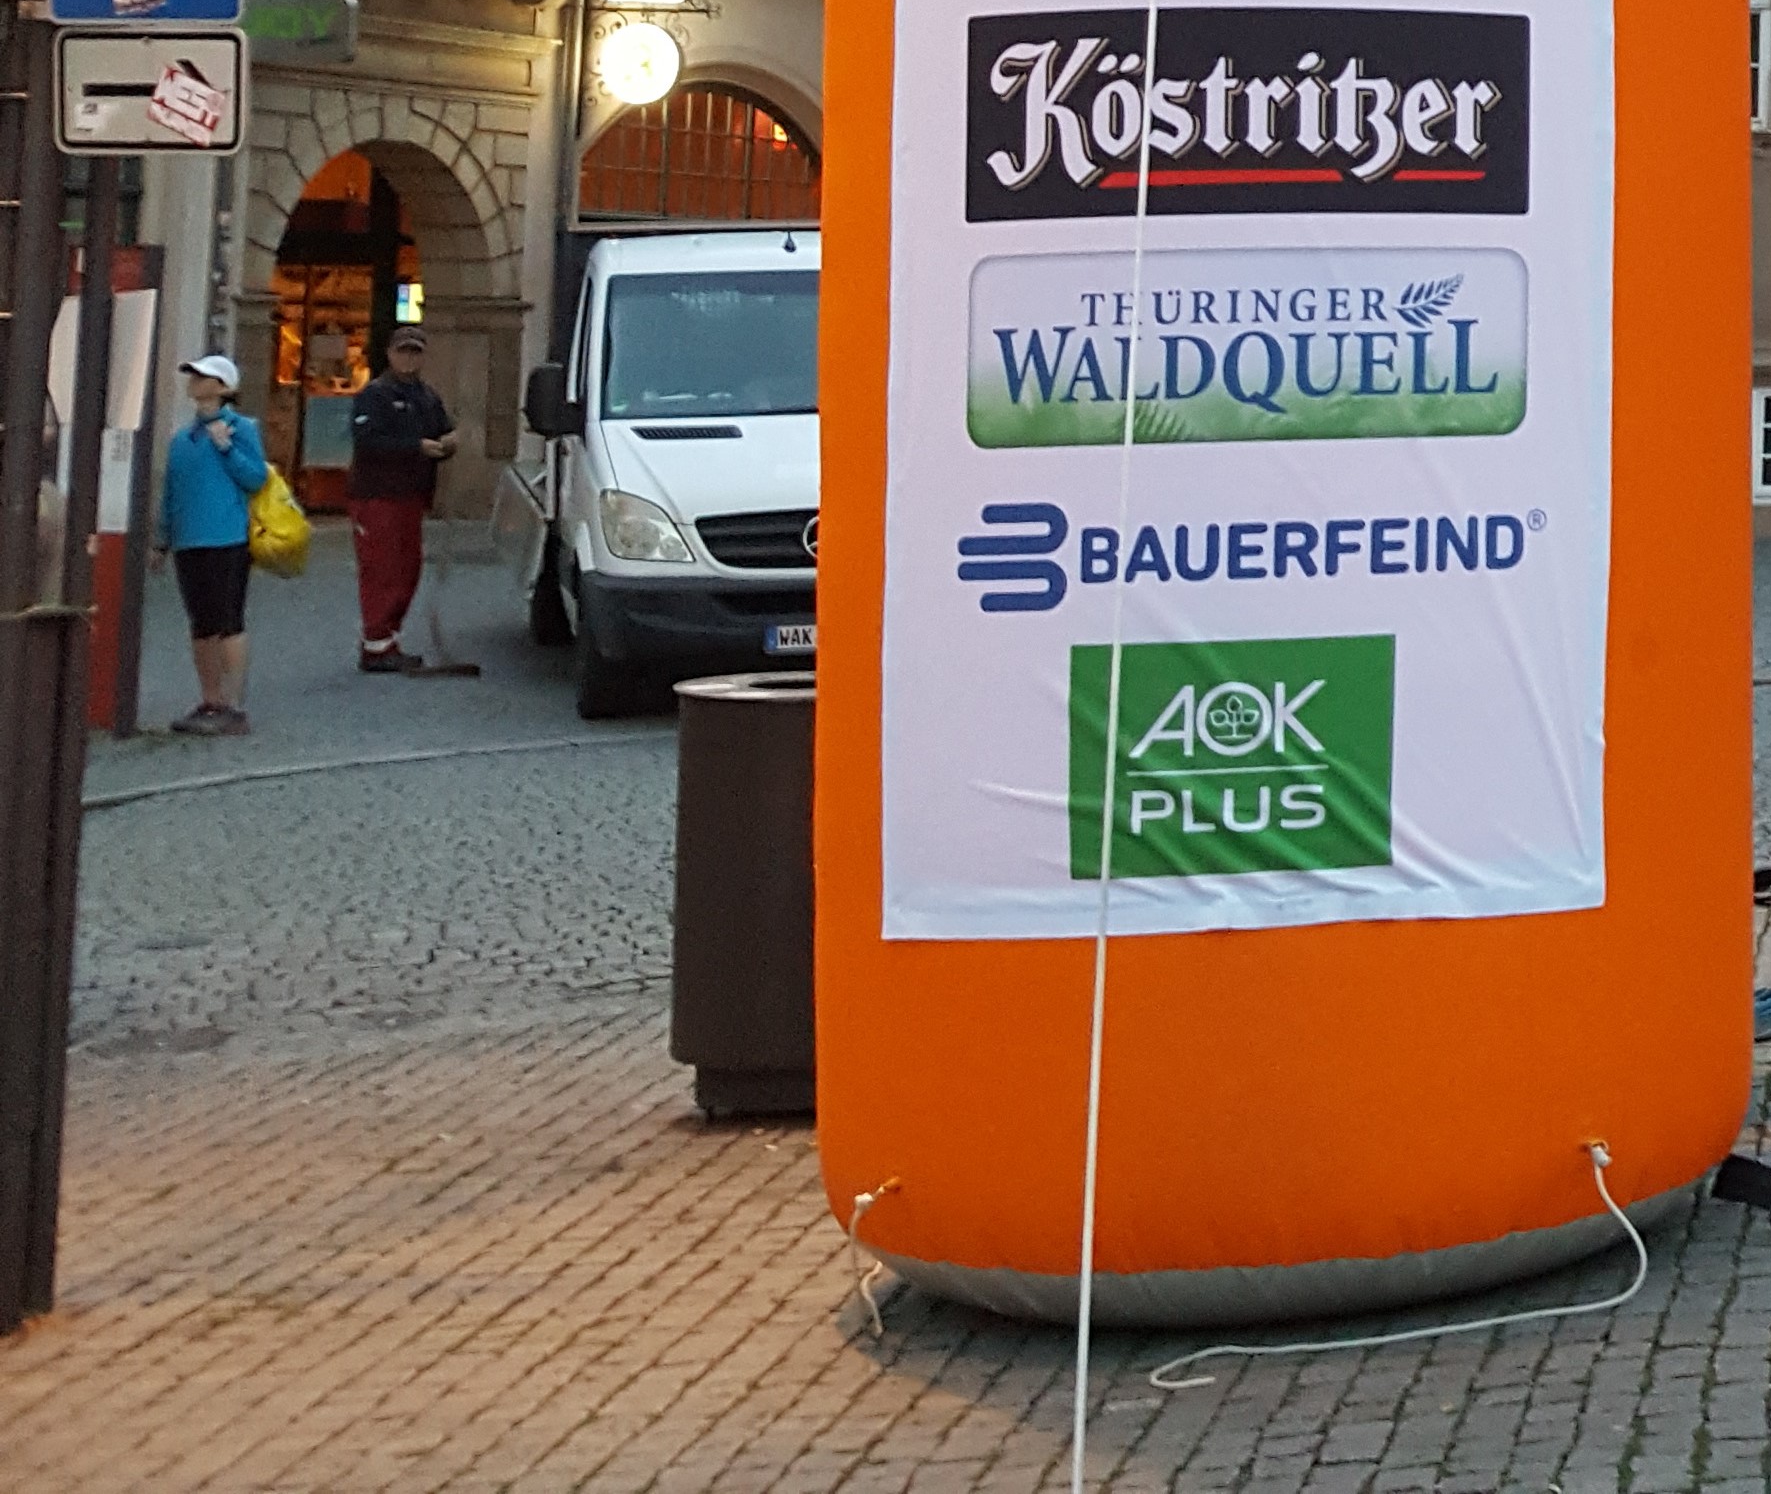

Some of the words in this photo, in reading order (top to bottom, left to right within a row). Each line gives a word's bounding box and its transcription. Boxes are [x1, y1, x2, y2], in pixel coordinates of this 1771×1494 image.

[986, 36, 1503, 190] Köstritzer
[1081, 288, 1390, 326] THÜRINGER
[992, 319, 1499, 414] WALDQUELL
[780, 627, 813, 646] WAK
[1128, 678, 1328, 759] AOK
[1128, 783, 1328, 836] PLUS
